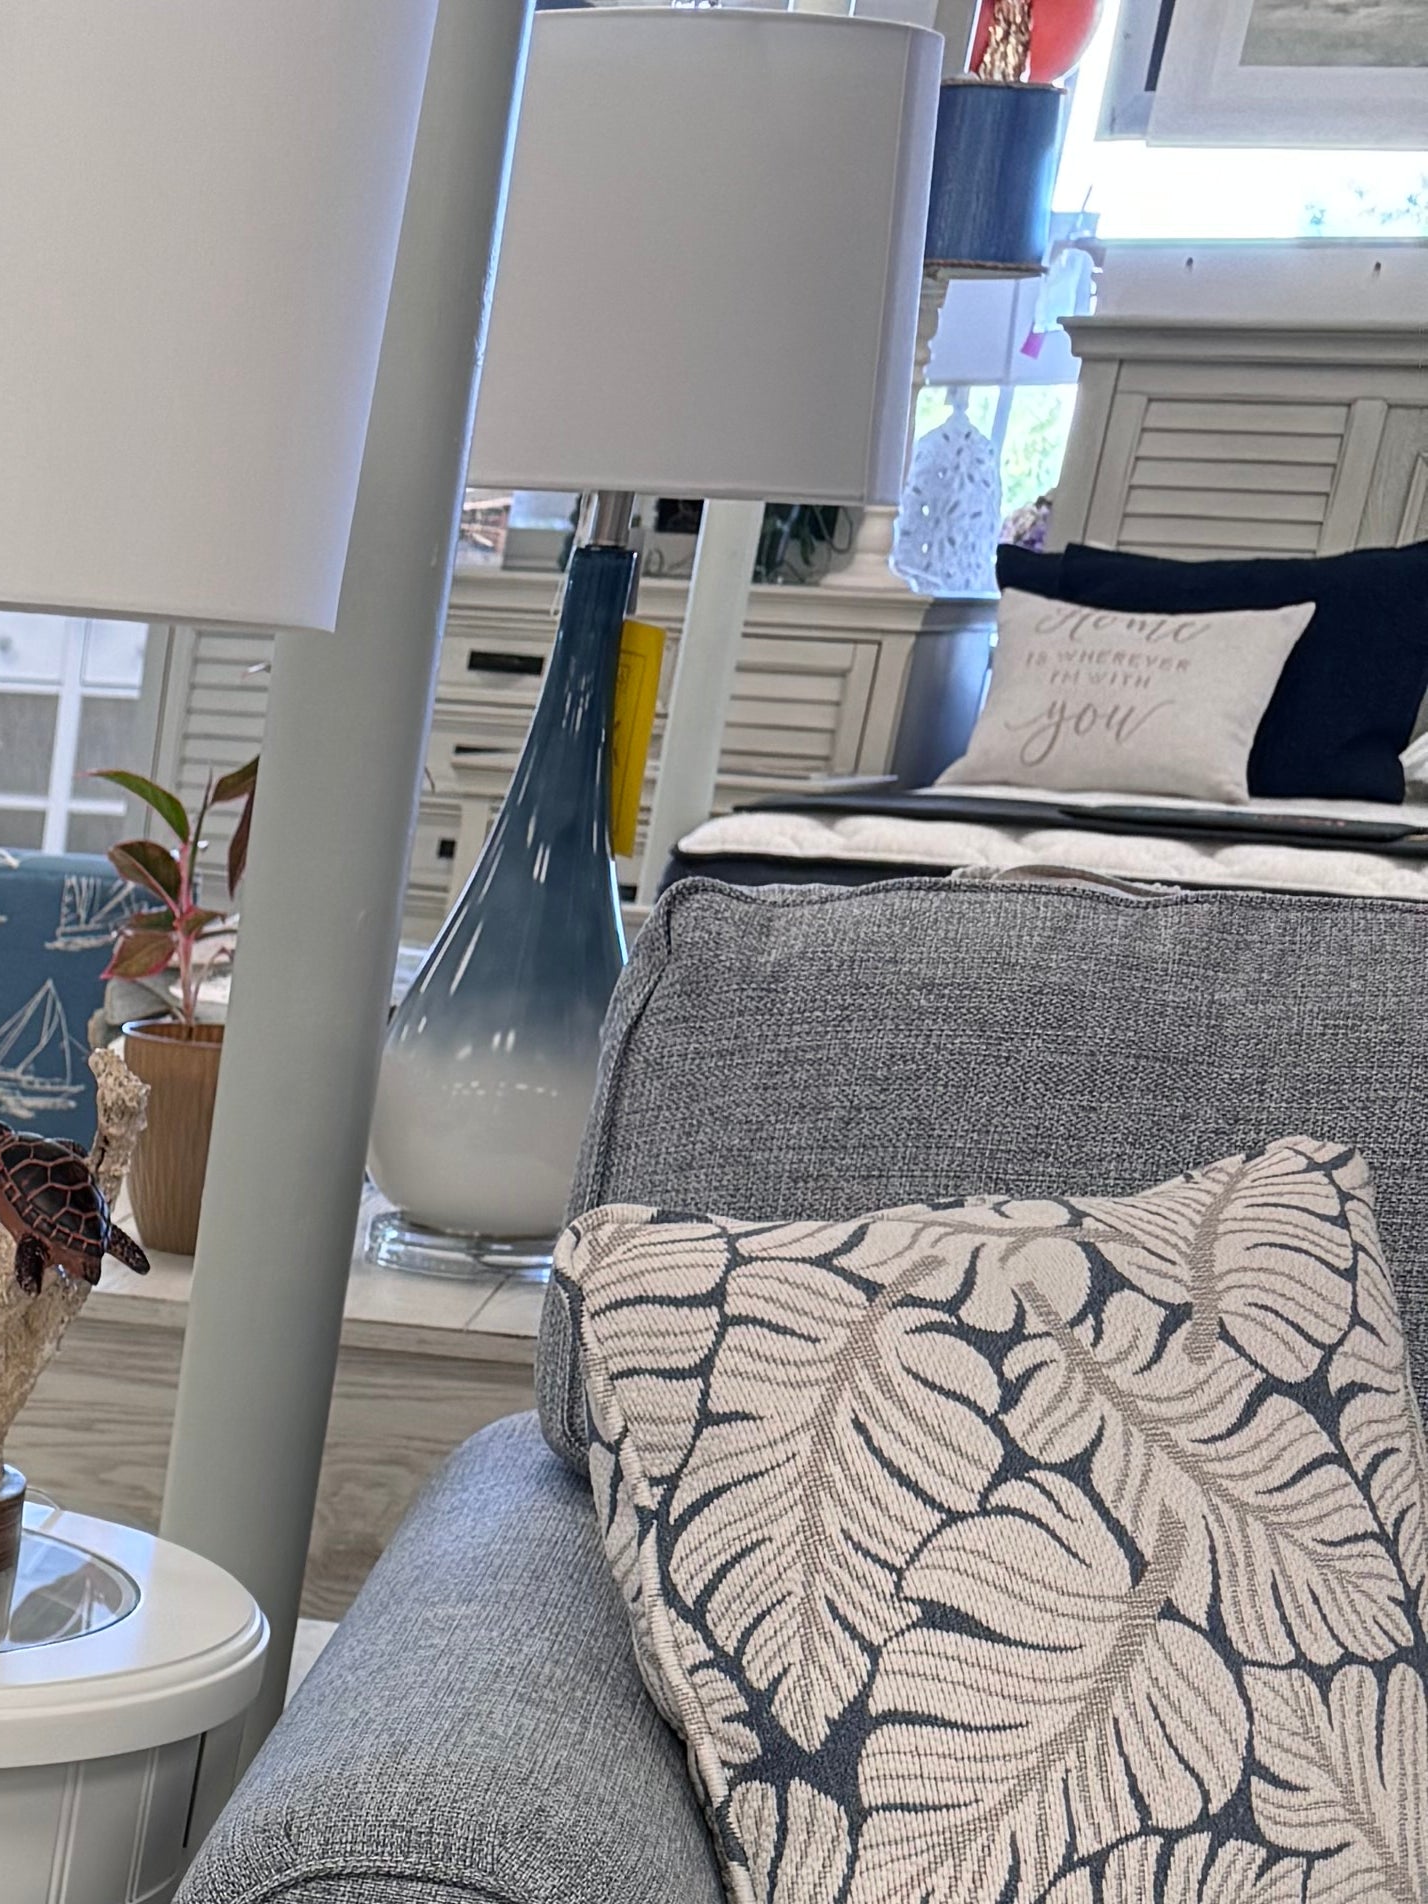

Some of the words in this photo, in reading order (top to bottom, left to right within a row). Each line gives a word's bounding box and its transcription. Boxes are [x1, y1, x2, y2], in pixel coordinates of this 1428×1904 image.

[1025, 652, 1049, 668] IS
[1056, 650, 1191, 673] WHEREVER
[1089, 672, 1151, 690] WITH
[1003, 700, 1177, 768] you
